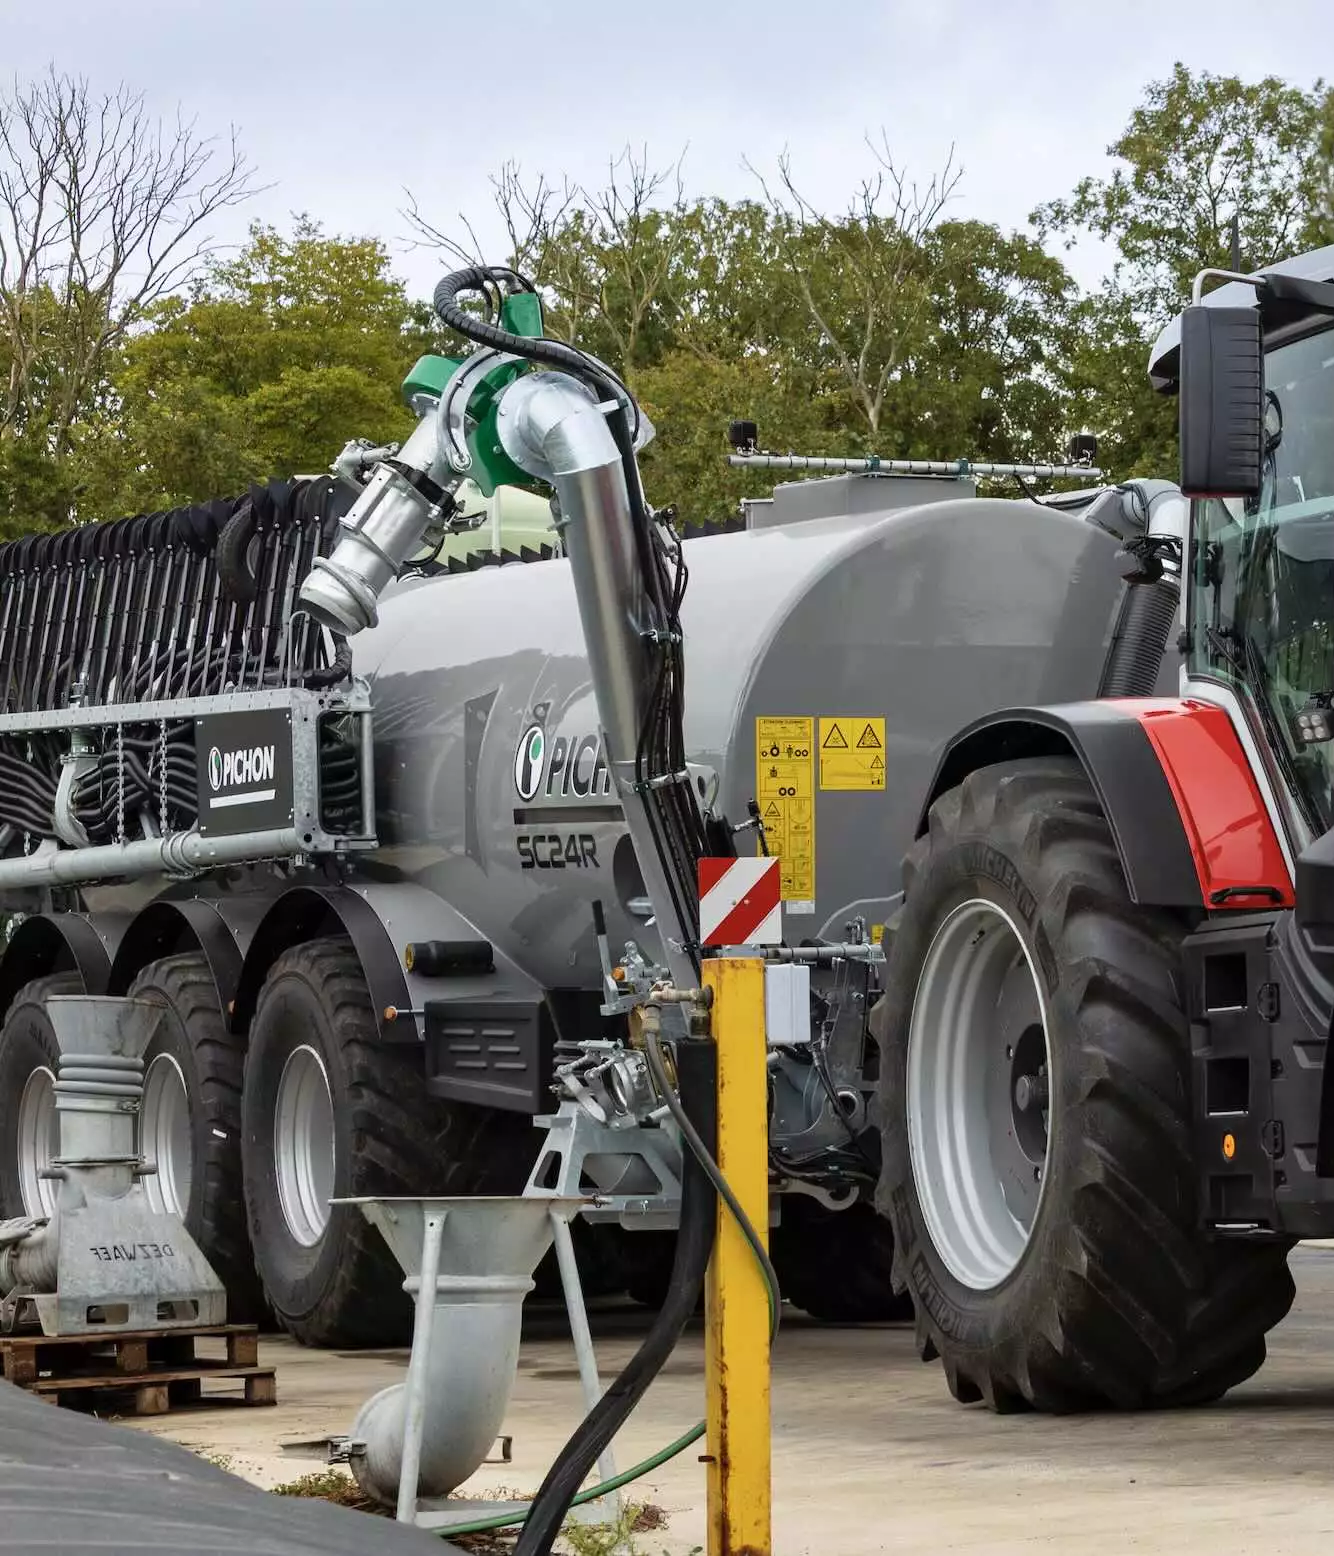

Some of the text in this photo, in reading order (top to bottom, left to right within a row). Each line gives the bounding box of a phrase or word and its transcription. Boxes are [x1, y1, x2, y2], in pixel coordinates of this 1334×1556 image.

[223, 745, 275, 787] PICHON
[545, 734, 611, 797] PICH
[517, 834, 600, 869] SC24R
